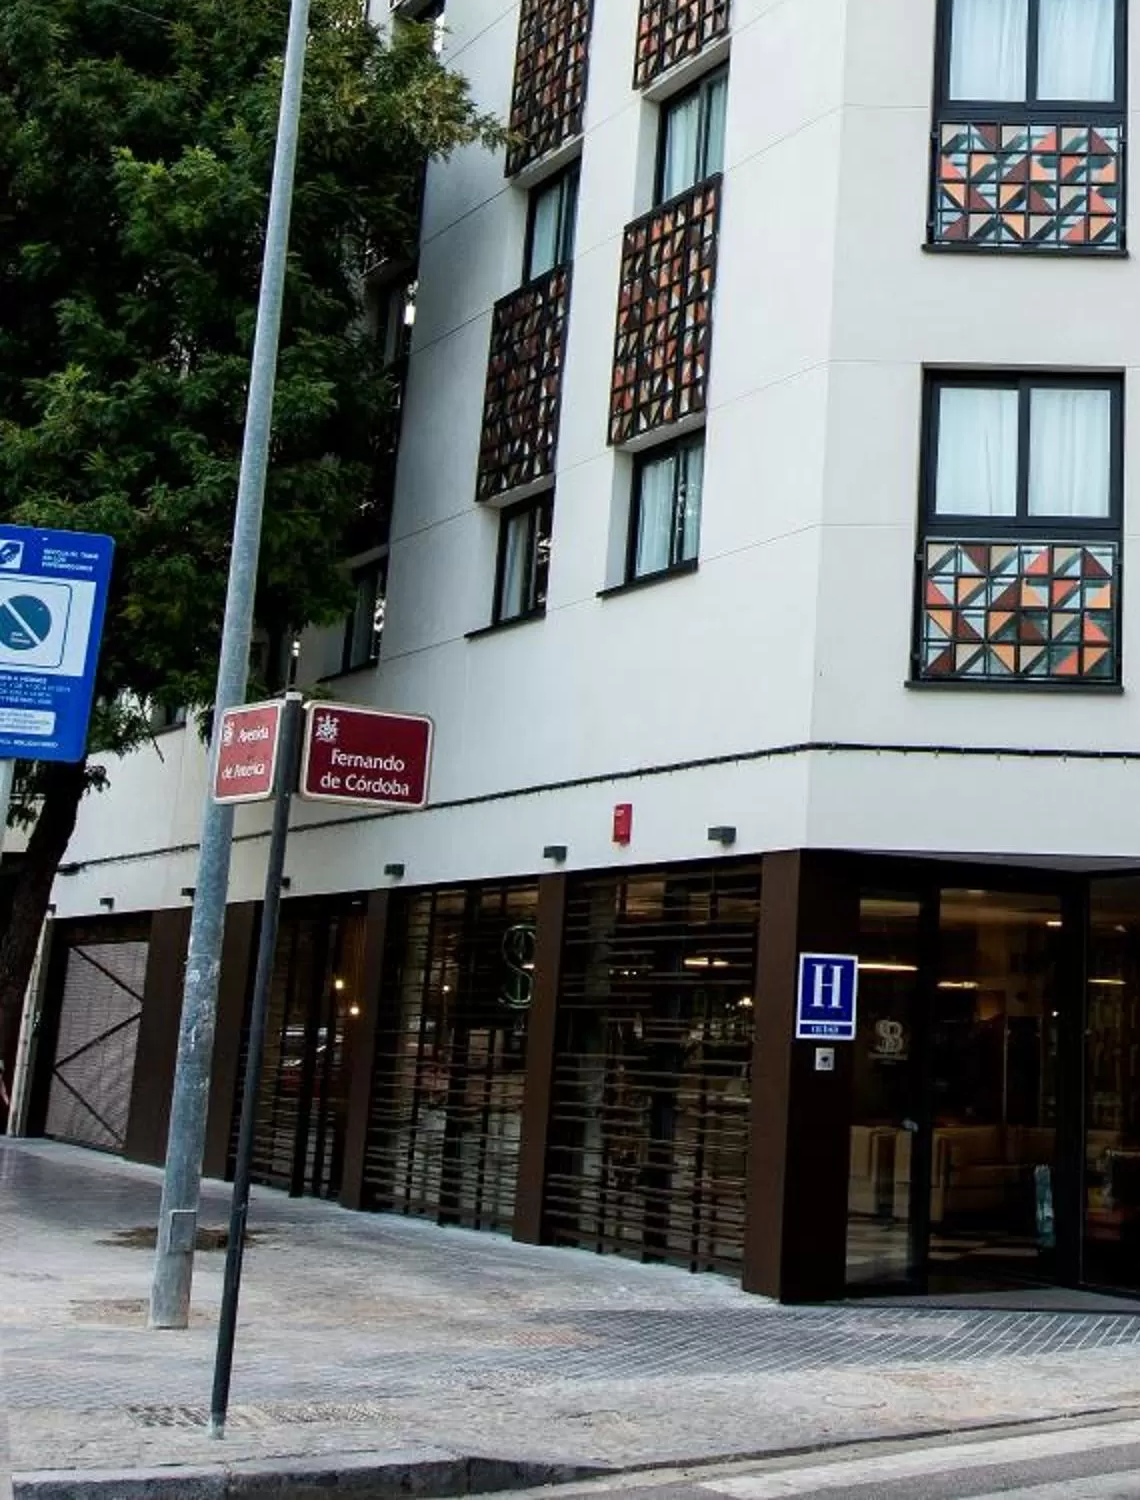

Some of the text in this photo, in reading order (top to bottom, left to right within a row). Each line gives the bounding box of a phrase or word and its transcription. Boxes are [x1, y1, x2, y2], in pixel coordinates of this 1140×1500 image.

[331, 748, 405, 772] Fernando
[320, 771, 410, 797] de Córdoba
[809, 963, 845, 1009] H
